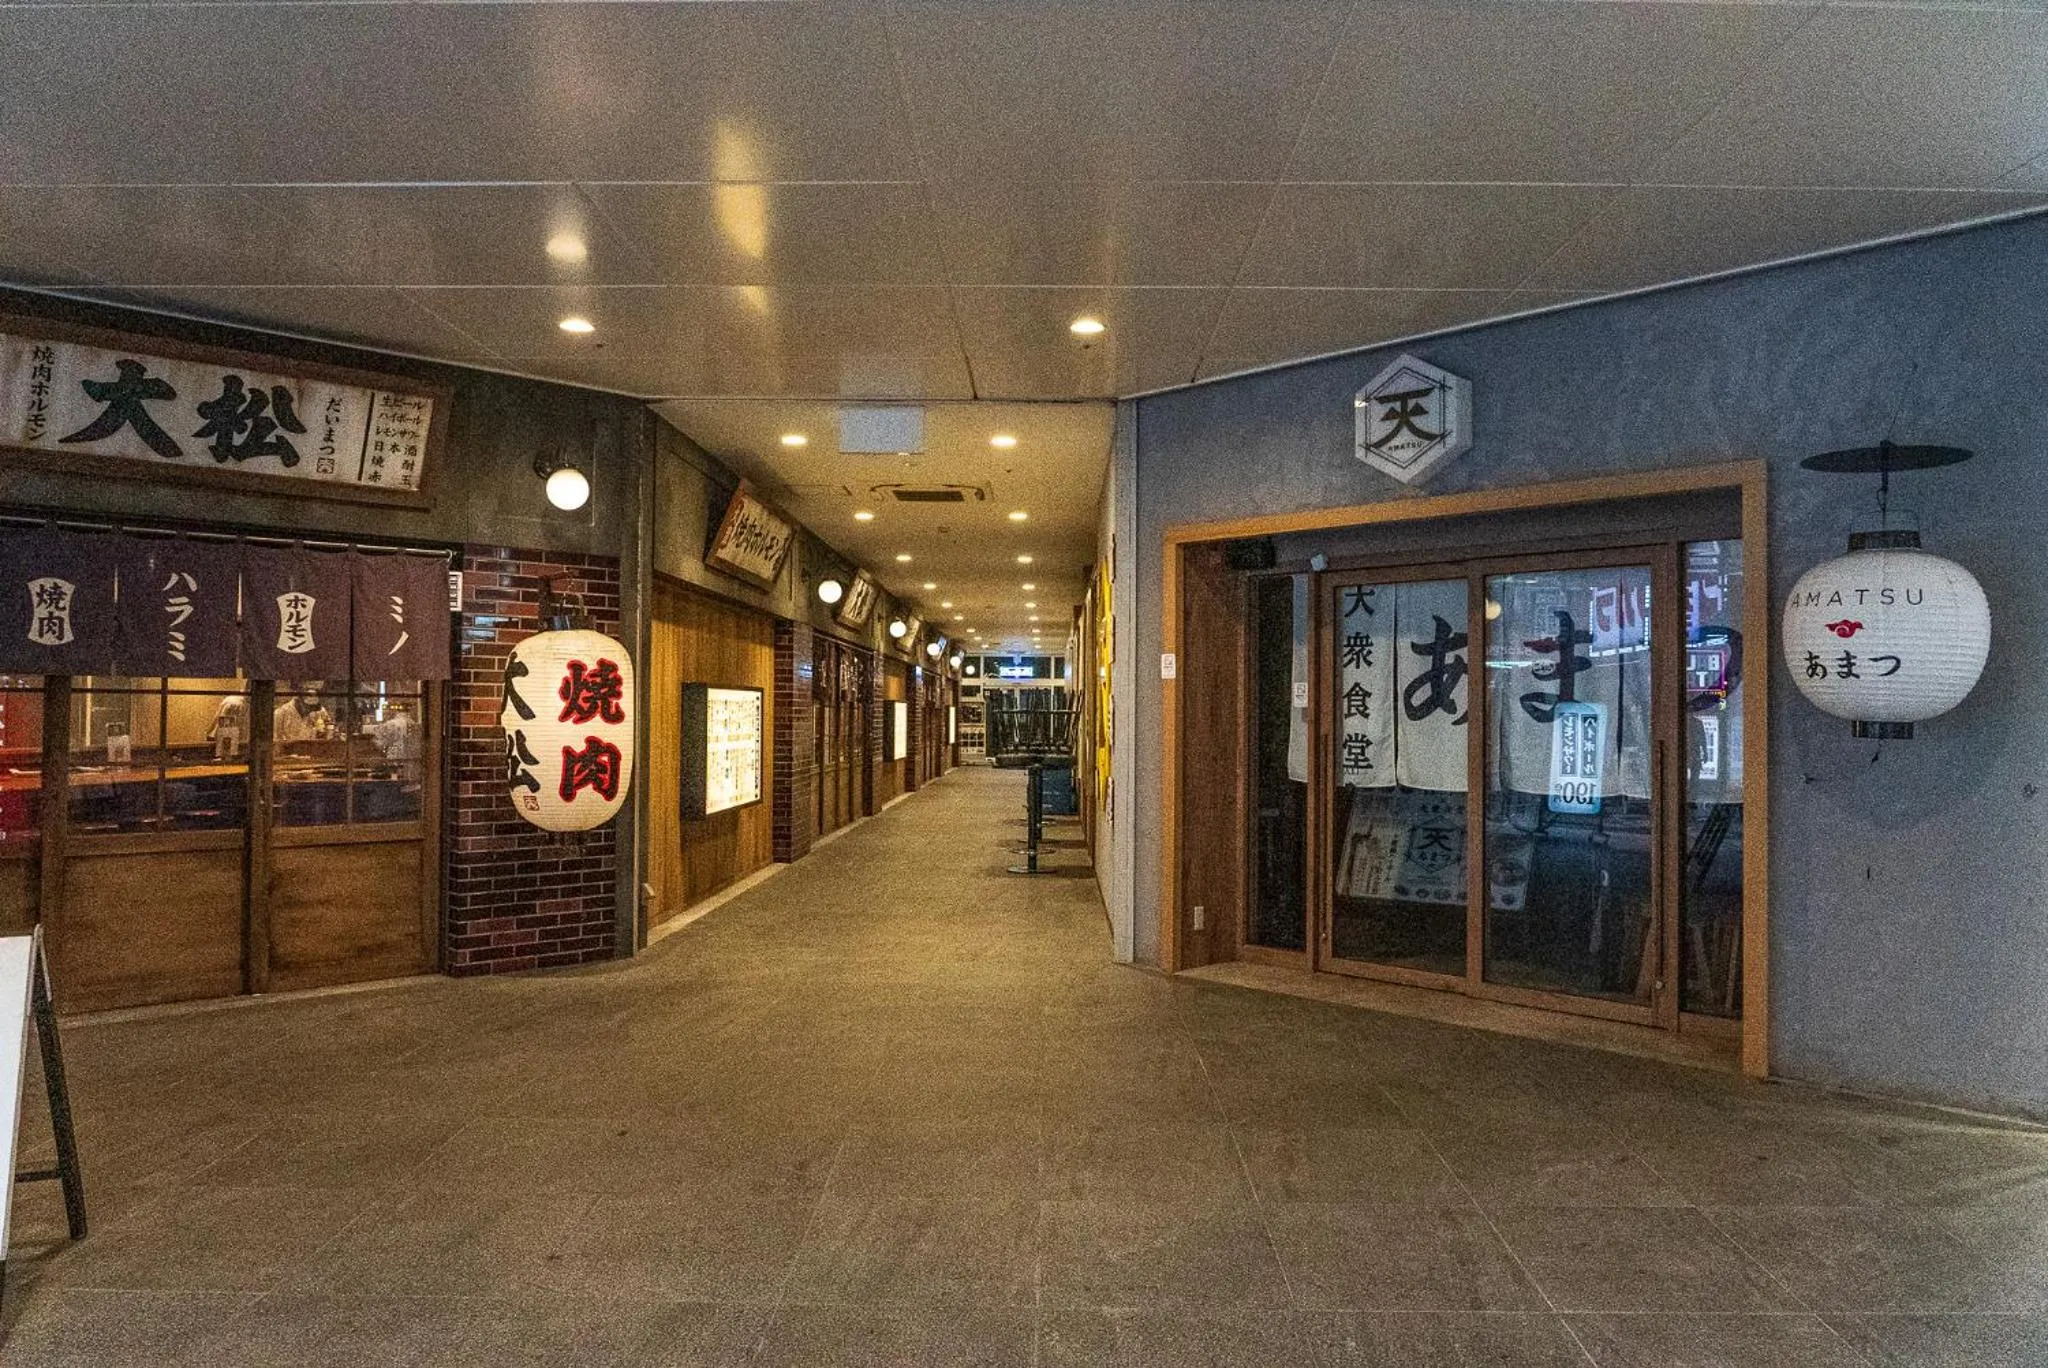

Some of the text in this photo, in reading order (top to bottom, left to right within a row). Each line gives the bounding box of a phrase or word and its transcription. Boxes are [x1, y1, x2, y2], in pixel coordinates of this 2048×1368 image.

[28, 346, 55, 442] 焼肉ホルモン
[58, 358, 307, 468] 大松
[1373, 385, 1441, 449] 天
[319, 397, 343, 456] だいまつ
[1388, 441, 1423, 451] AMATSU
[35, 583, 68, 641] 焼肉
[163, 572, 198, 662] ハラミ
[284, 595, 312, 652] ホルモン
[388, 596, 409, 655] ミノ
[1792, 588, 1924, 608] AMATSU
[1342, 586, 1374, 771] 大衆食堂
[1803, 650, 1901, 680] あまつ
[558, 658, 626, 803] 焼肉
